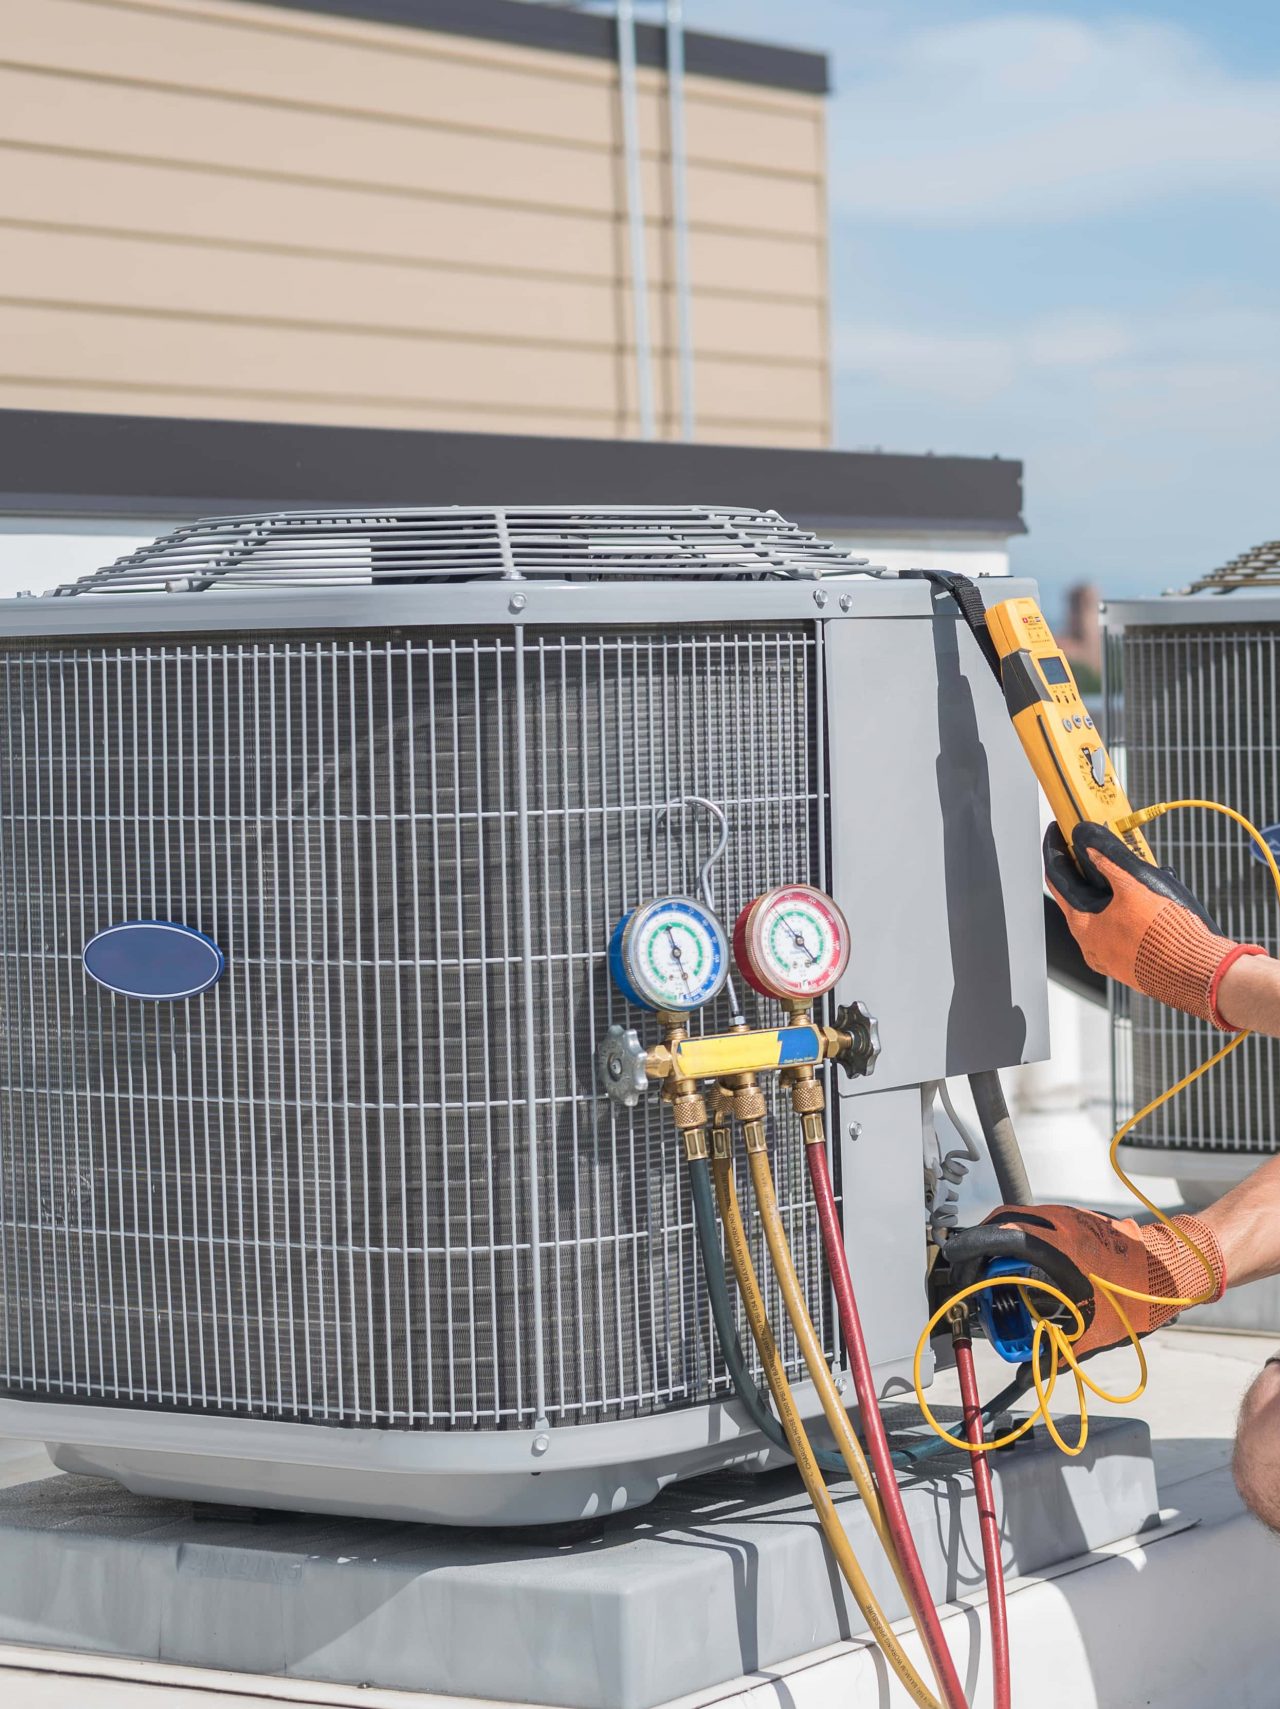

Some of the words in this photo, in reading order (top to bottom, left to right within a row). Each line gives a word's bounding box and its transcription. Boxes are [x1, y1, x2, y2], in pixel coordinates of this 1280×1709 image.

[727, 1212, 741, 1248] WORKING
[735, 1248, 750, 1282] MAXIMUM
[778, 1390, 787, 1402] PSI
[787, 1417, 798, 1436] HOSE
[793, 1435, 812, 1470] CHARGING
[864, 1602, 888, 1638] PRESSURE
[882, 1636, 902, 1666] WORKING
